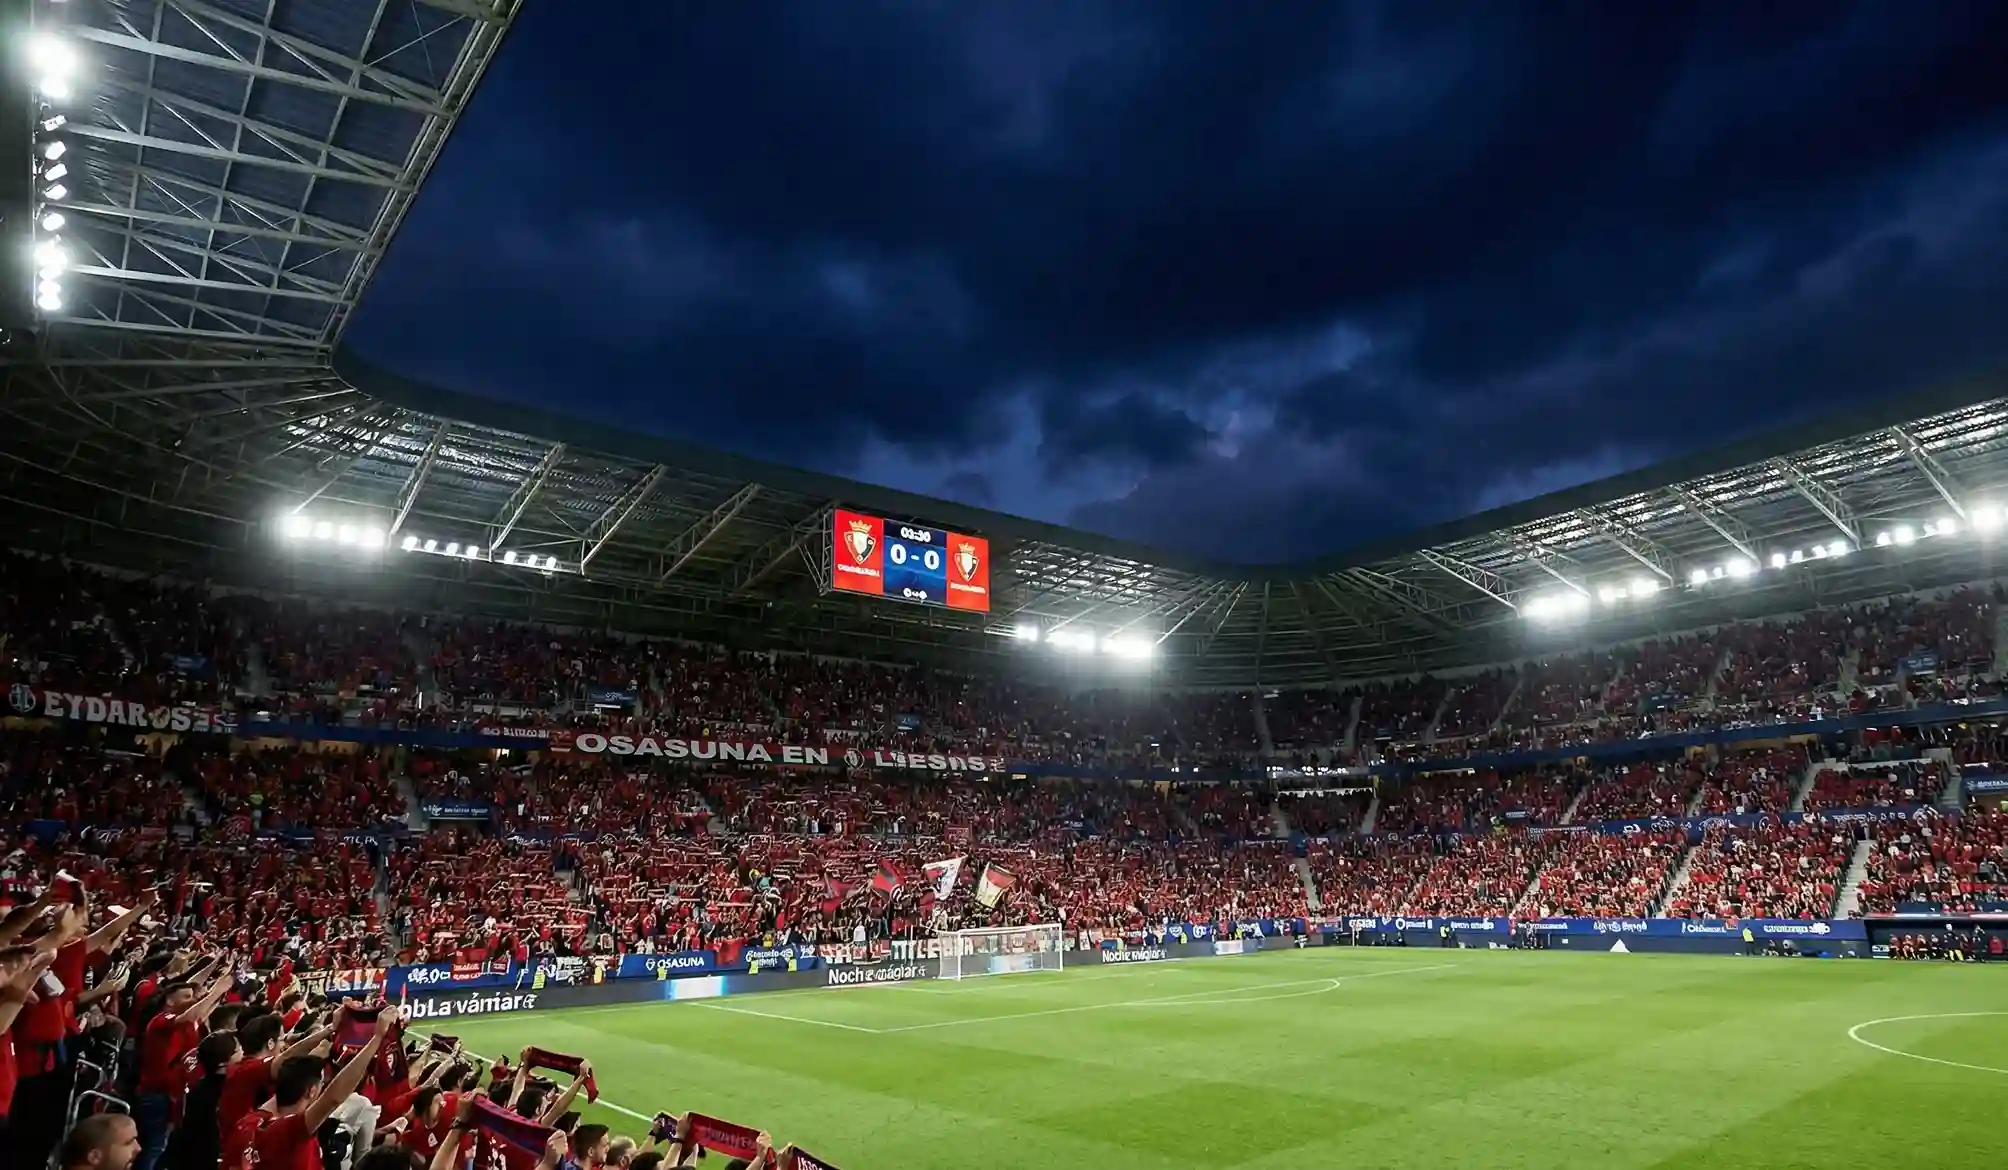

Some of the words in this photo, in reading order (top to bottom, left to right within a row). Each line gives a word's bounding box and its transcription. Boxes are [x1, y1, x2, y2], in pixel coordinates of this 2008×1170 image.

[890, 543, 907, 565] 0
[924, 550, 940, 570] 0
[575, 732, 772, 762] OSASUNA
[782, 746, 828, 765] EN
